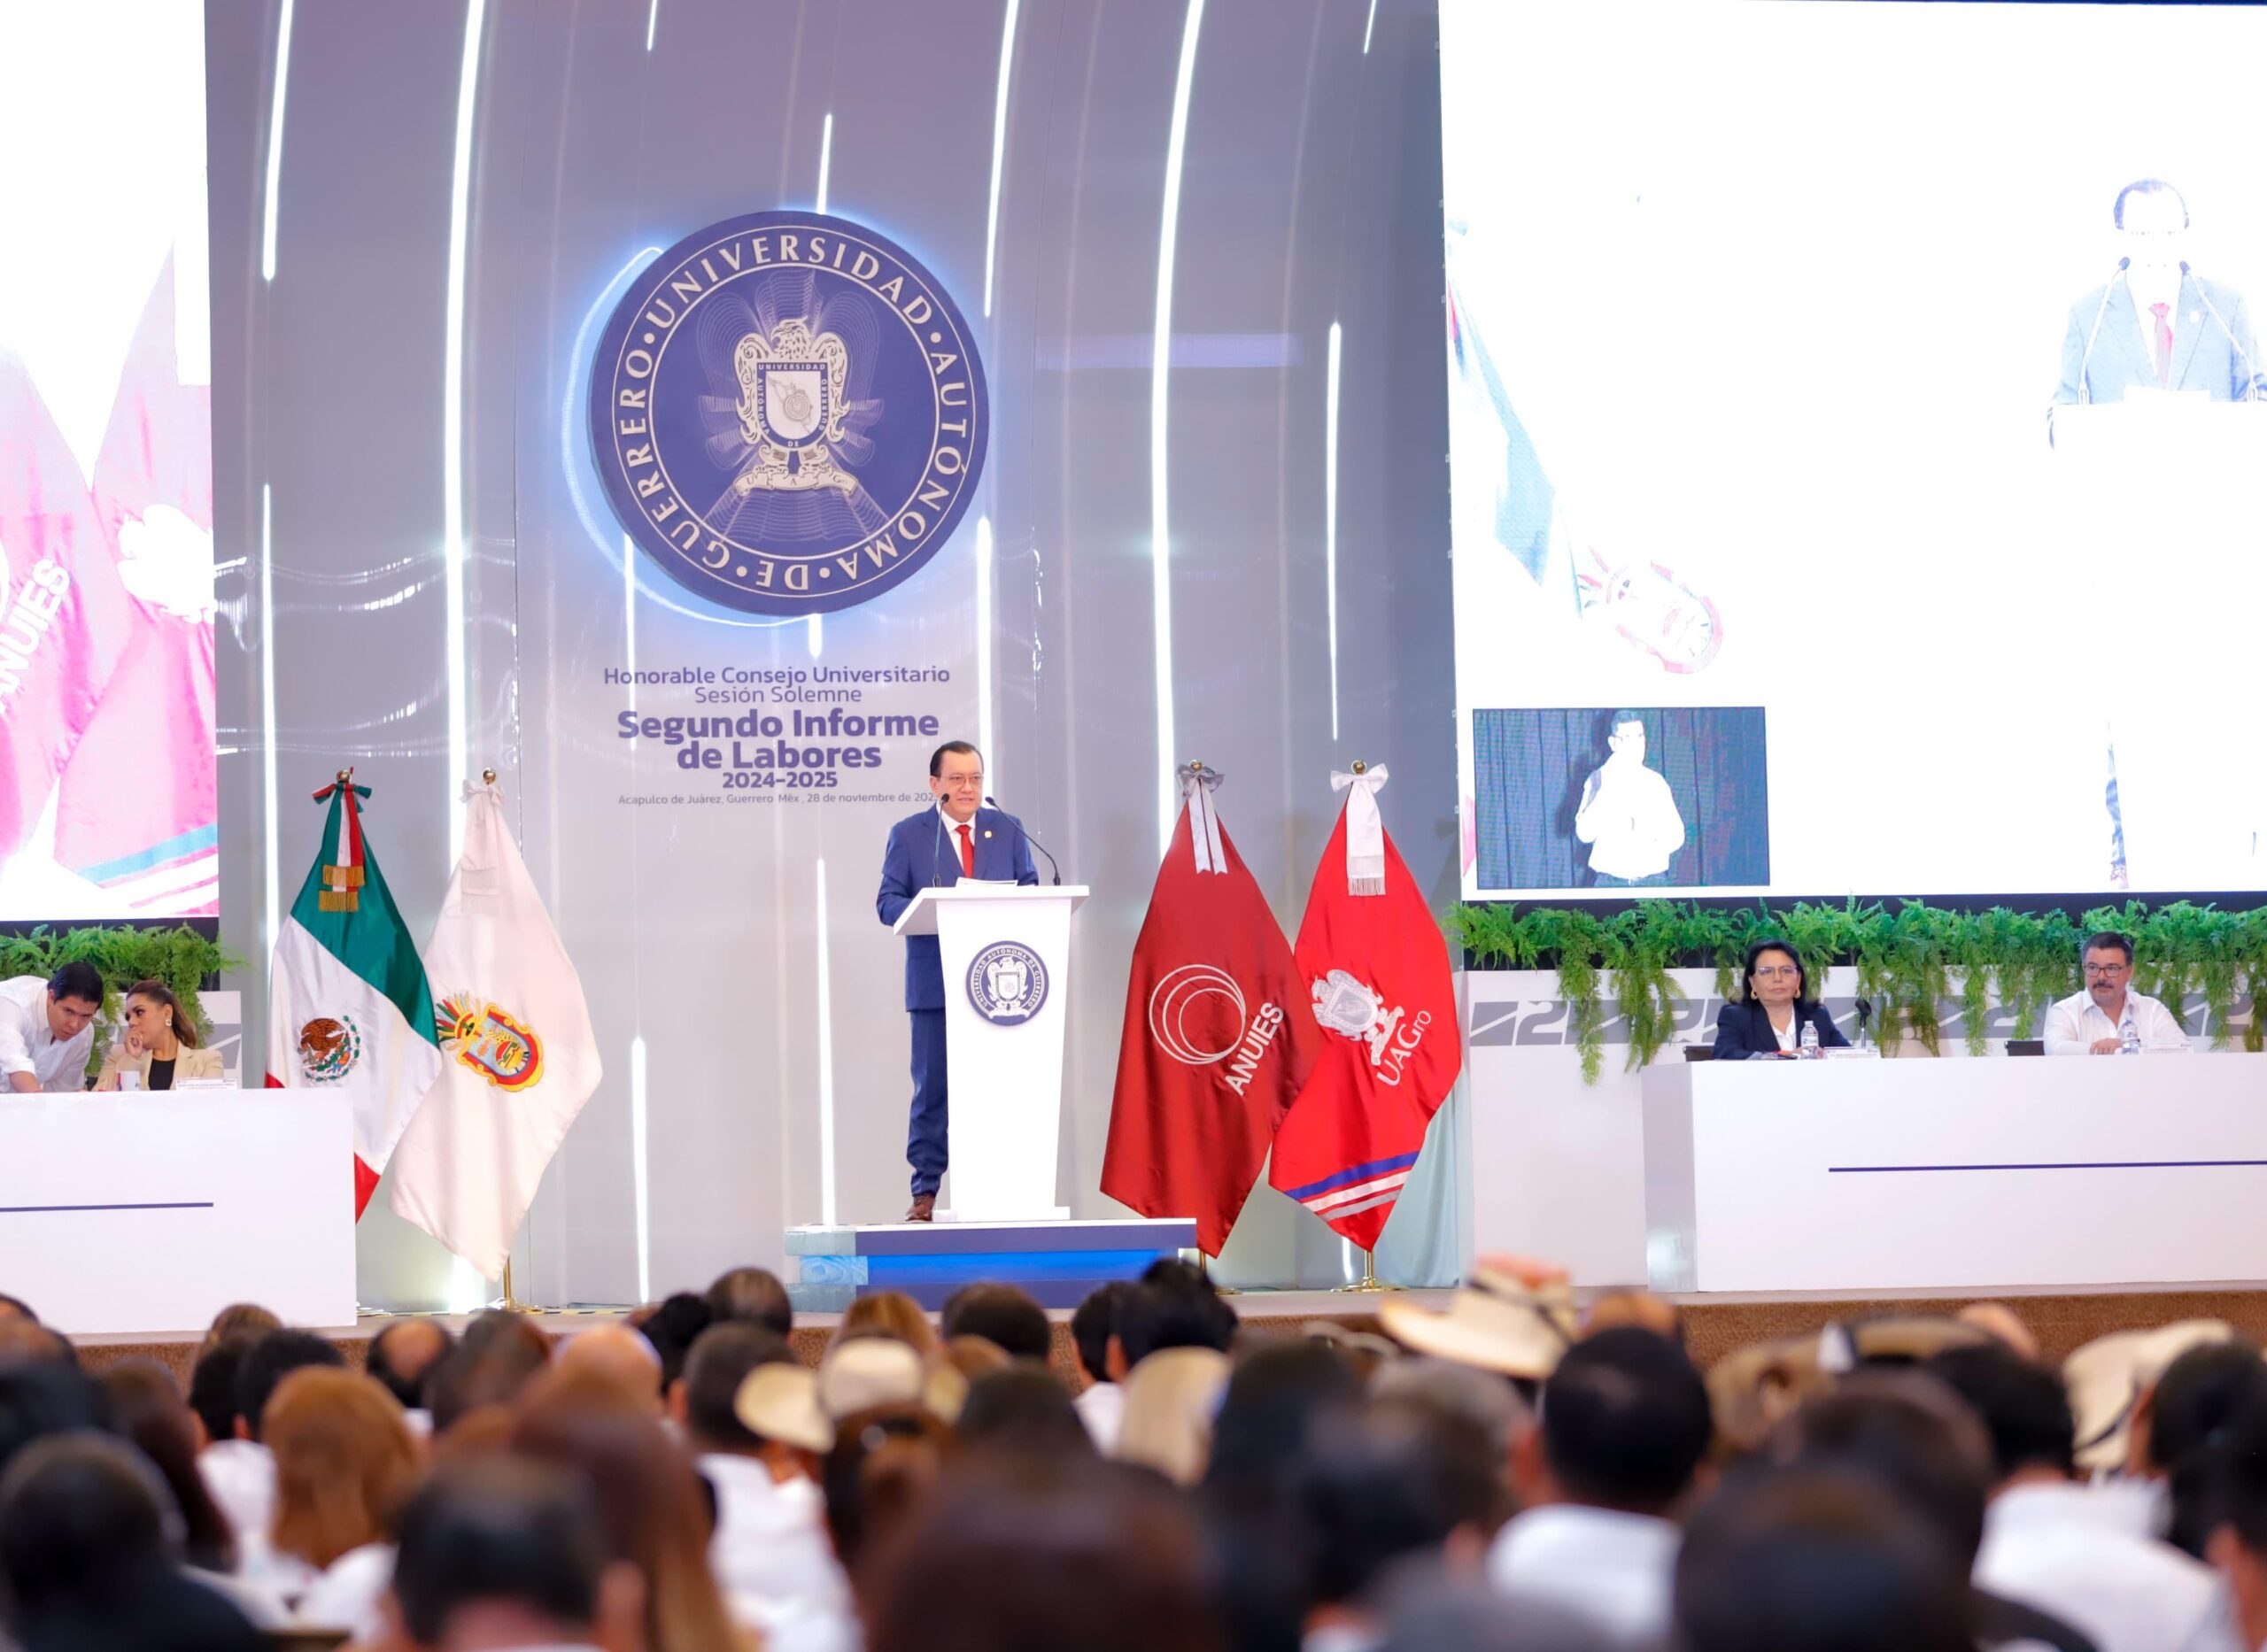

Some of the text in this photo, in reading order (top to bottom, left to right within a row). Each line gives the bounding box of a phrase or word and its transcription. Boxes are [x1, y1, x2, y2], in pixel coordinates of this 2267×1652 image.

[619, 235, 967, 591] UNIVERSIDAD AUTÓNOMA DE GUERRERO
[0, 559, 70, 714] NUIES
[604, 666, 950, 688] Honorable Consejo Universitario
[694, 686, 862, 704] Sesión Solemne
[617, 708, 940, 745] Segundo Informe
[677, 740, 882, 769] de Labores
[723, 772, 838, 789] 2024-2025
[618, 795, 668, 806] Acapulco
[671, 795, 685, 804] de
[687, 793, 724, 805] Juárez,
[808, 793, 820, 803] 28
[823, 793, 836, 802] de
[839, 793, 895, 802] noviembre
[898, 792, 911, 801] de
[915, 792, 937, 802] 202
[1225, 1002, 1284, 1096] ANUIES
[1376, 1010, 1433, 1086] UAGro
